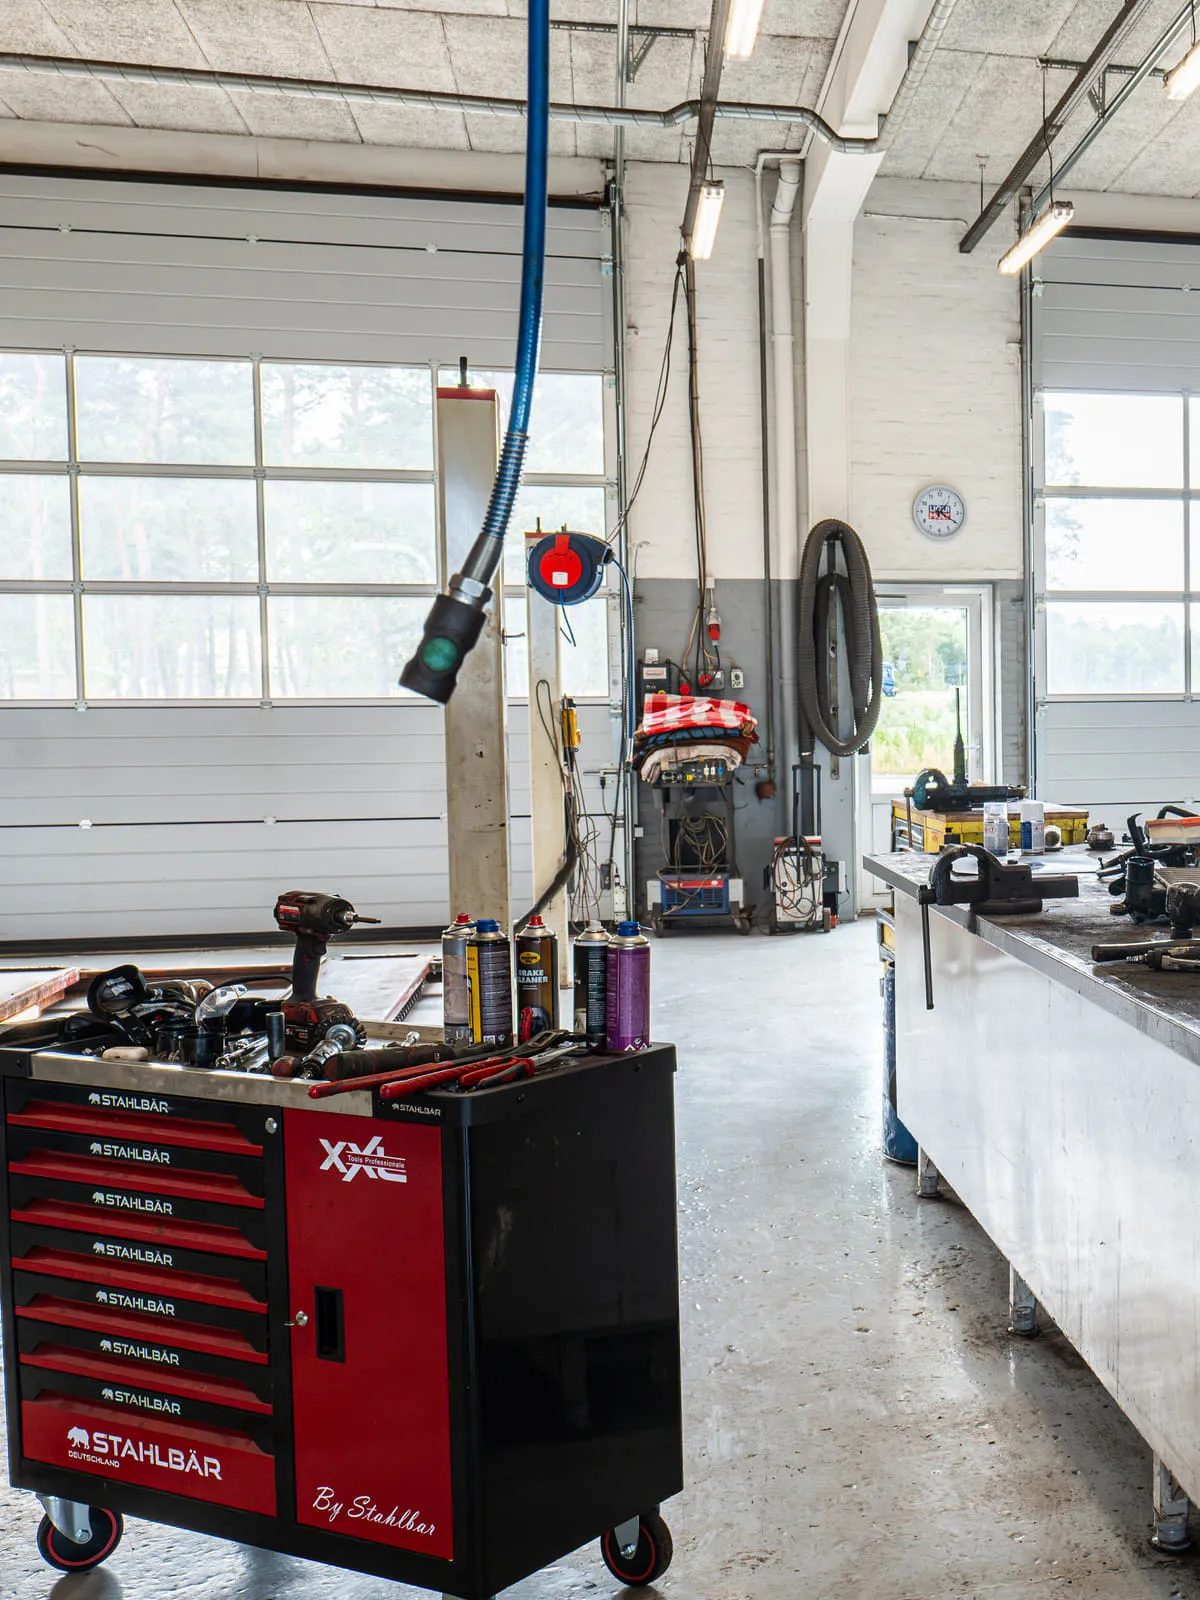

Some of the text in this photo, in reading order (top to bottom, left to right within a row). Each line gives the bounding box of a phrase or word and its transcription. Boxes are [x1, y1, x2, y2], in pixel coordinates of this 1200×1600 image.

[102, 1094, 169, 1113] STAHLBÄR
[103, 1144, 170, 1164] STAHLBÄR
[319, 1135, 407, 1183] XXL
[106, 1193, 173, 1215] STAHLBÄR
[106, 1244, 173, 1266] STAHLBÄR
[109, 1292, 175, 1316] STAHLBÄR
[113, 1342, 179, 1366] STAHLBÄR
[115, 1390, 181, 1415] STAHLBÄR
[68, 1449, 120, 1468] DEUTSCHLAND
[92, 1432, 223, 1481] STAHLBÄR
[312, 1486, 435, 1536] By Stahlbar
